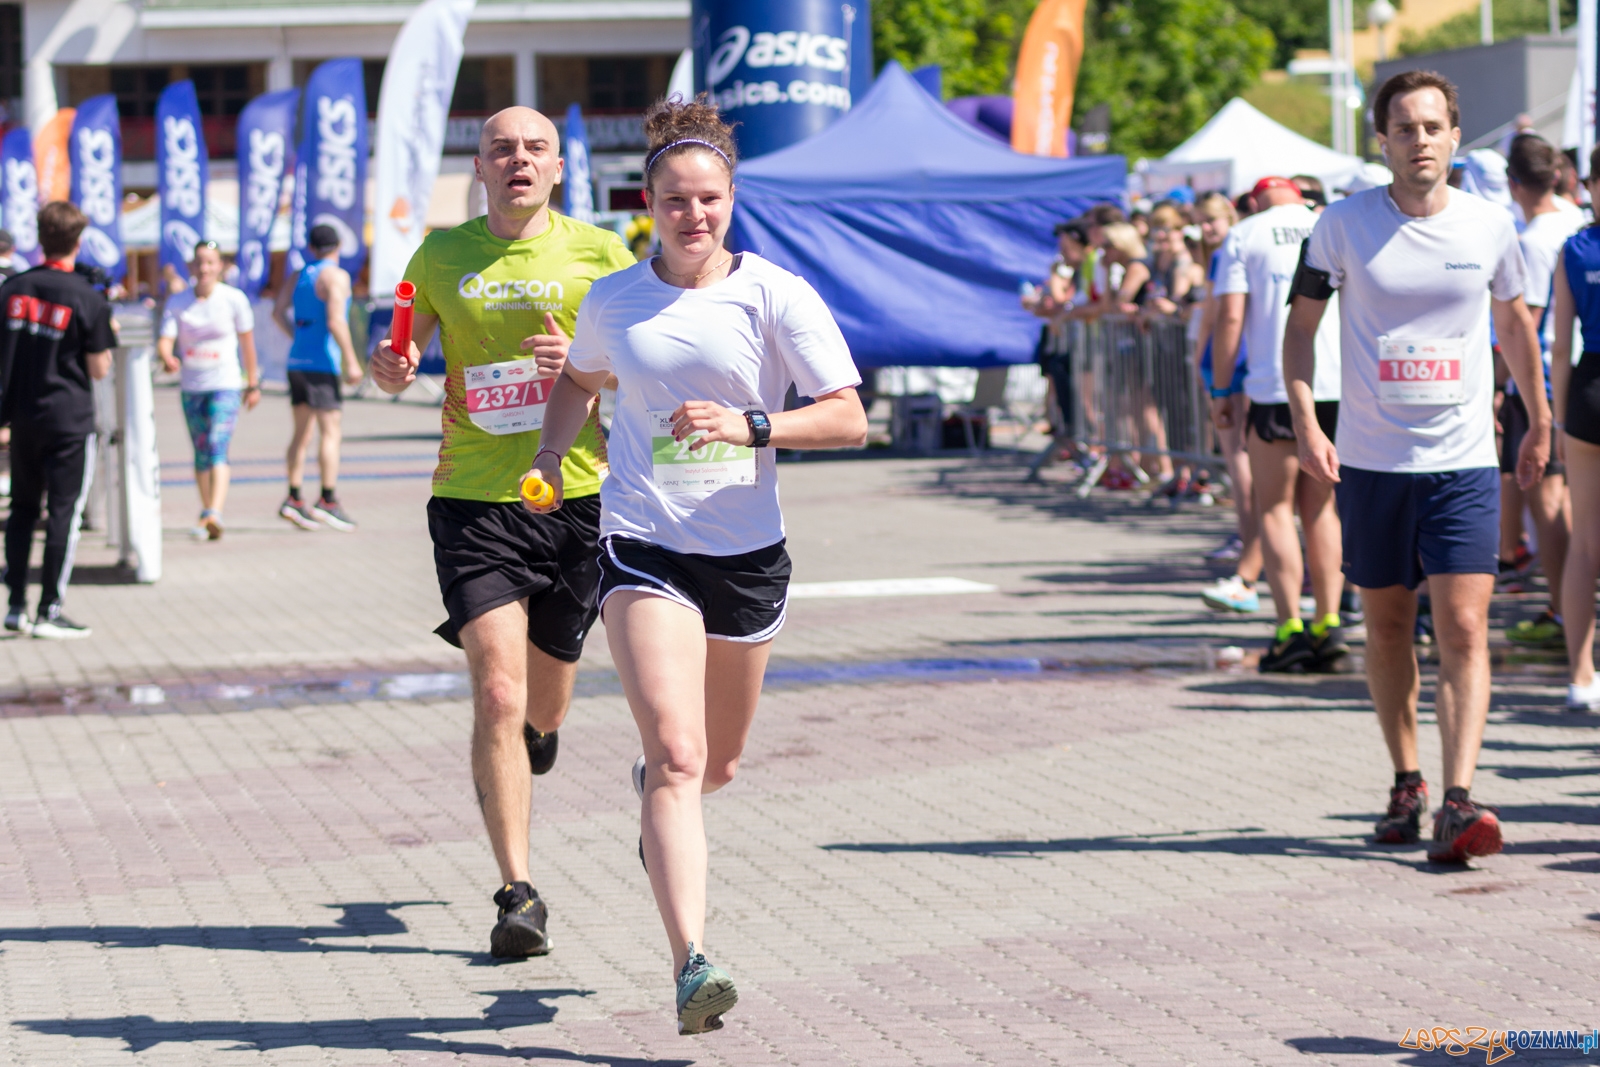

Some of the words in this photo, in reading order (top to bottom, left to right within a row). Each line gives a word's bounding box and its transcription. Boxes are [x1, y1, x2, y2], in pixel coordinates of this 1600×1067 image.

[745, 31, 848, 72] asics
[78, 126, 115, 226] asics
[164, 115, 200, 218] asics
[247, 128, 285, 236] asics
[316, 95, 357, 210] asics
[6, 157, 38, 252] asics
[458, 272, 563, 300] Qarson
[485, 301, 532, 311] RUNNING
[534, 301, 563, 311] TEAM
[475, 381, 544, 410] 232/1
[1389, 361, 1451, 380] 106/1
